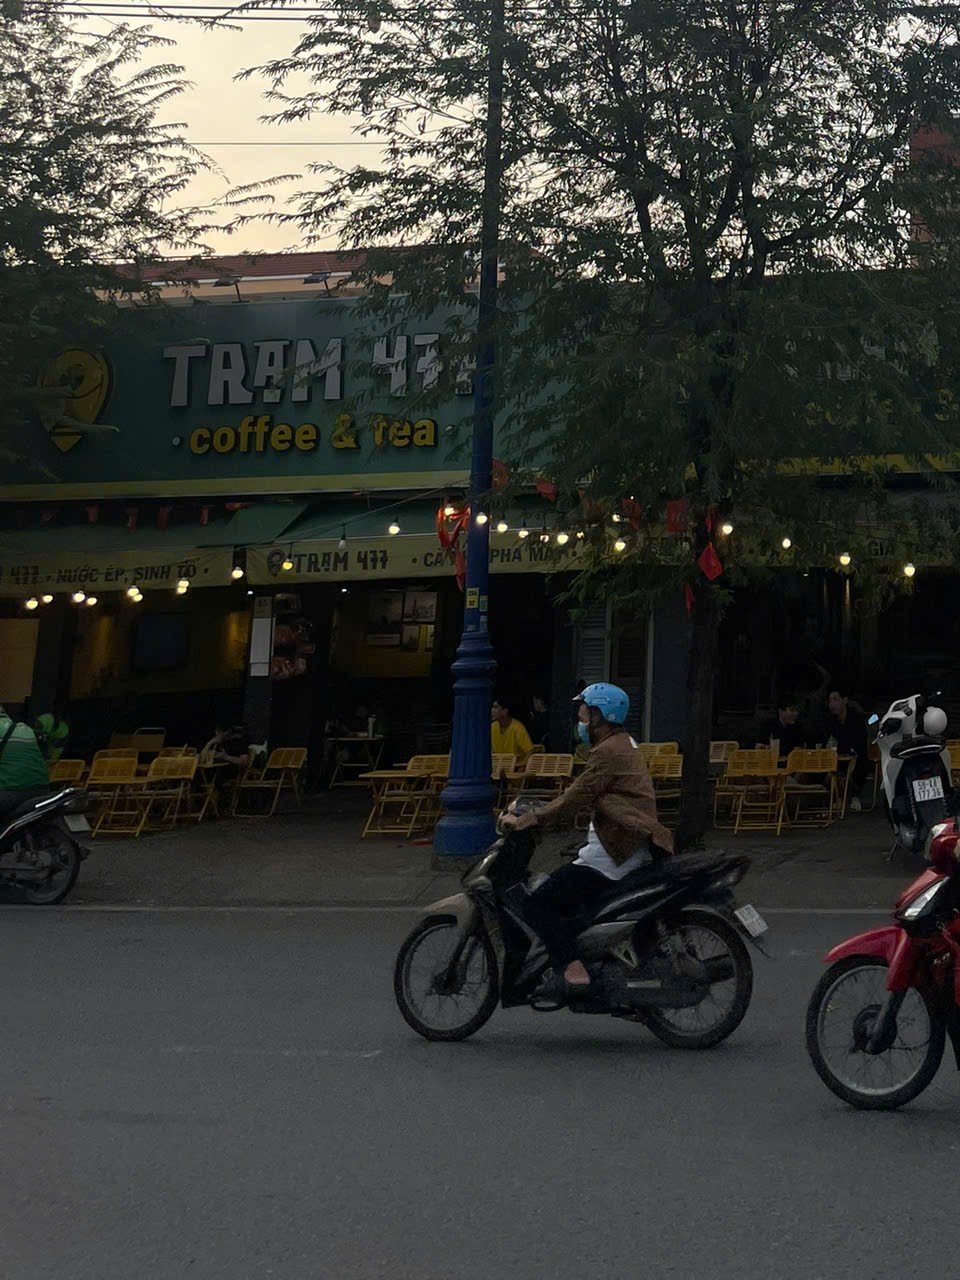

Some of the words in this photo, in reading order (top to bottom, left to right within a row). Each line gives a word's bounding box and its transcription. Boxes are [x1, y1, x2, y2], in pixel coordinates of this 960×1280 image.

[189, 414, 319, 456] coffee
[331, 412, 361, 450] &
[372, 412, 439, 449] tea
[356, 549, 389, 570] 477
[10, 564, 40, 585] 477
[134, 565, 171, 581] SINH
